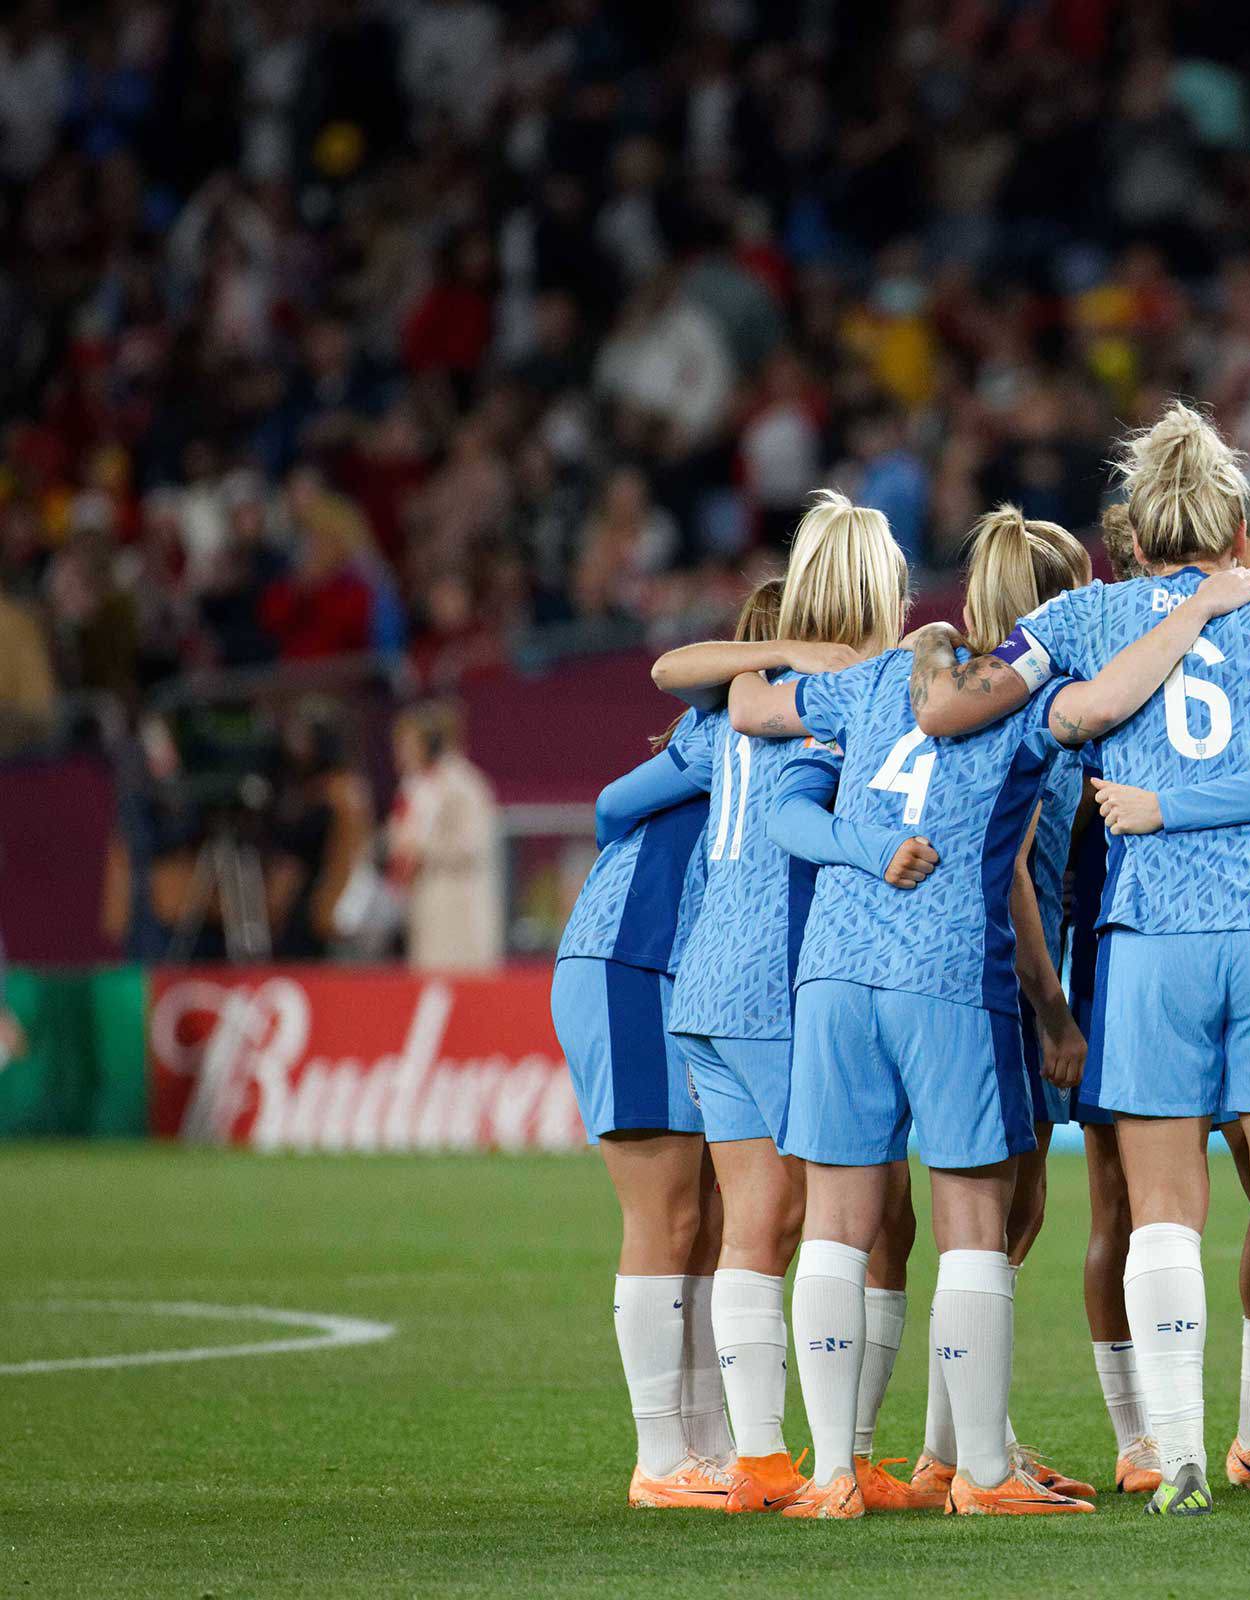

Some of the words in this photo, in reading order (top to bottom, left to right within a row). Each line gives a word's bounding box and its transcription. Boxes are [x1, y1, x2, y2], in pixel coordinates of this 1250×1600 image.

[1164, 636, 1232, 760] 6
[709, 735, 751, 861] 11
[866, 725, 938, 825] 4
